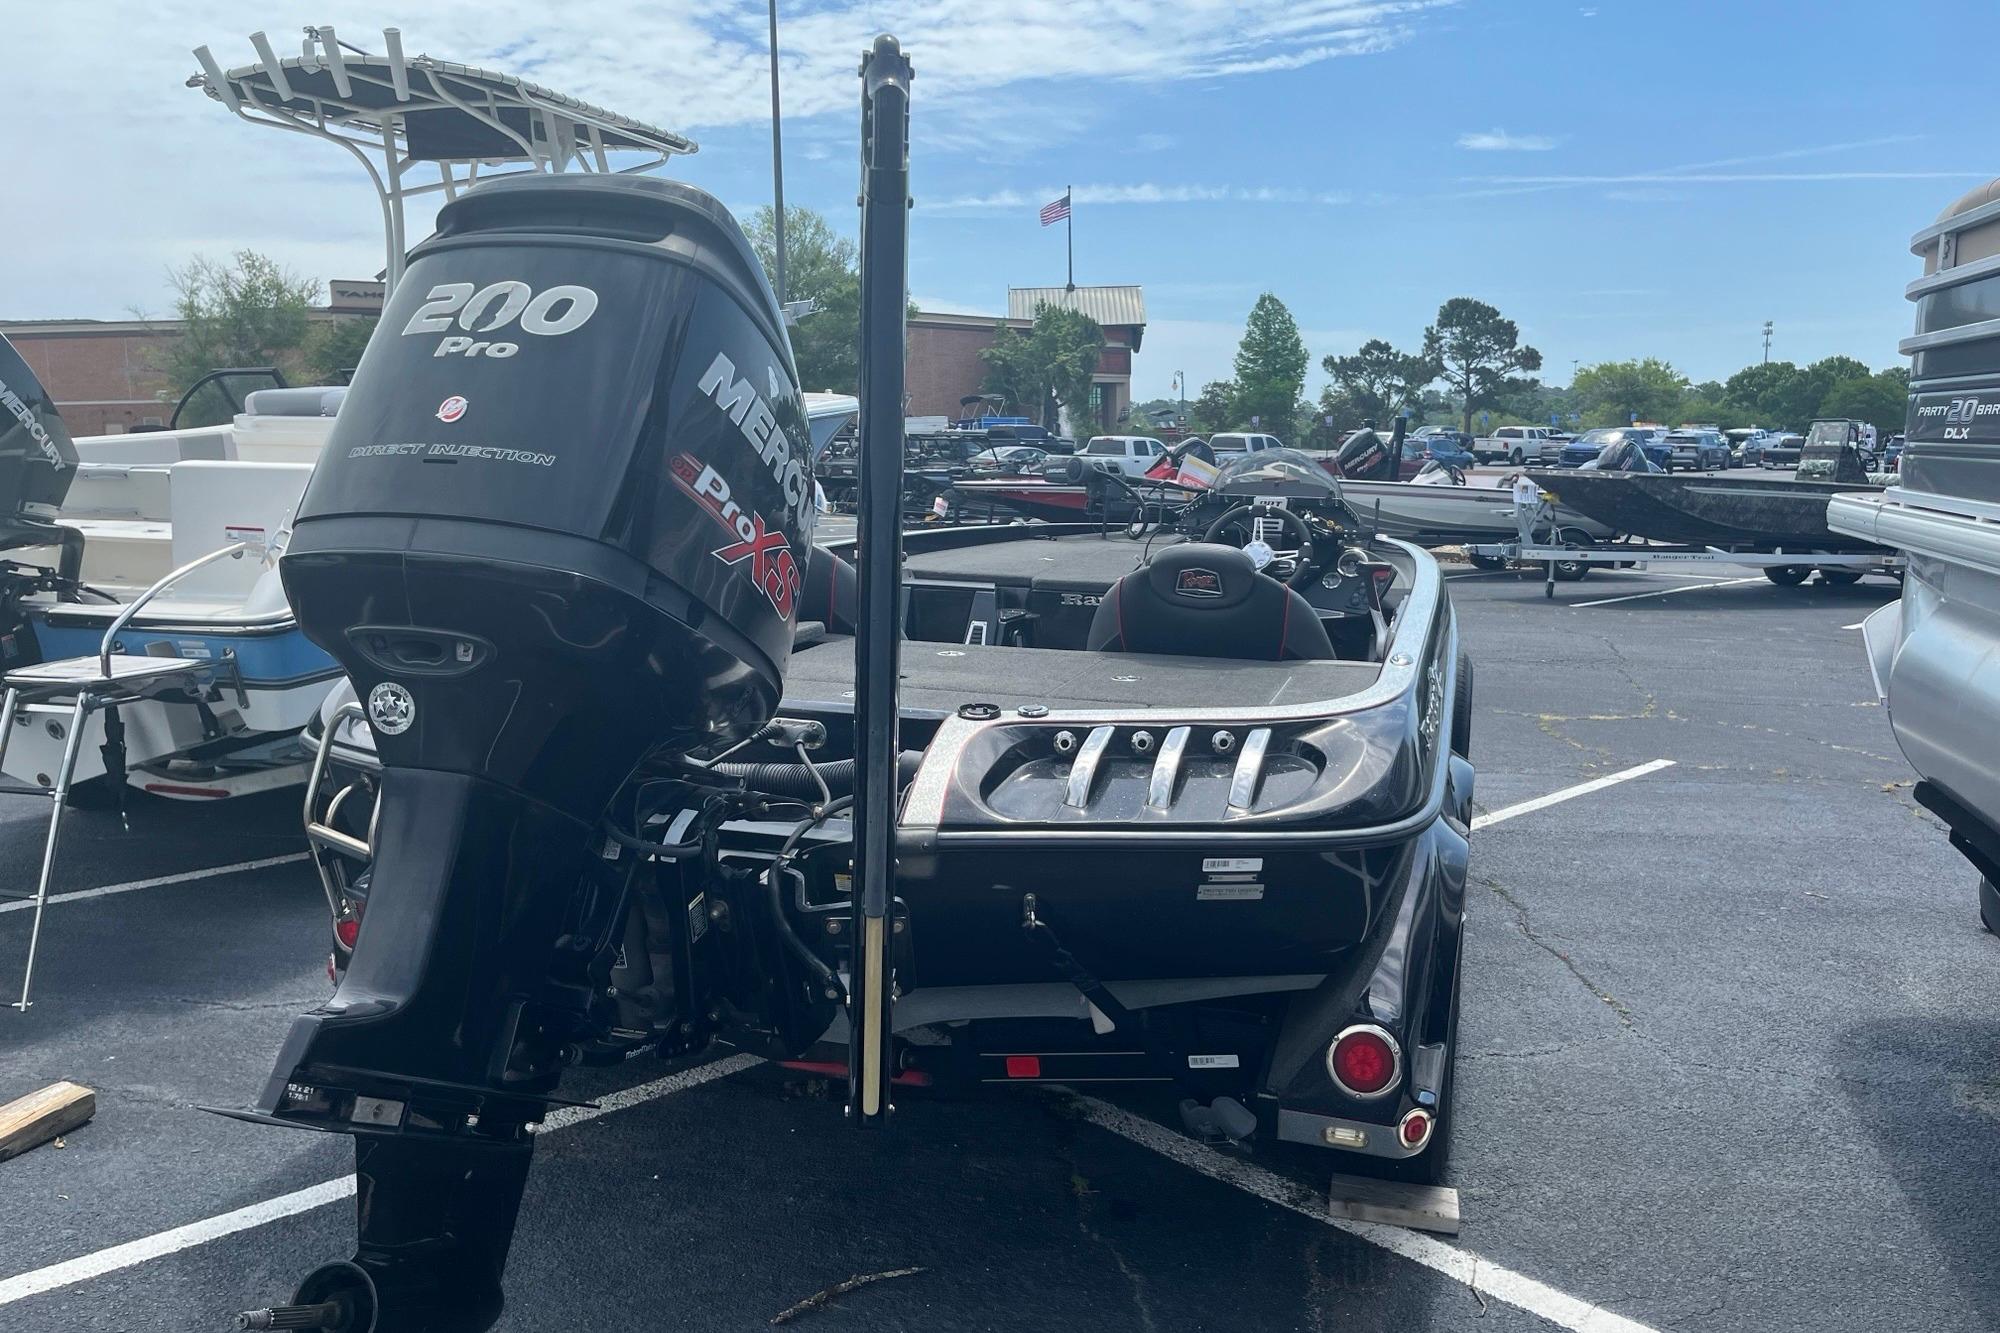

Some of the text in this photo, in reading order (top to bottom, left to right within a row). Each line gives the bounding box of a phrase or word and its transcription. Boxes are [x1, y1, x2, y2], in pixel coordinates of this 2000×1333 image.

[401, 280, 599, 336] 200
[433, 336, 519, 358] Pro
[1917, 396, 2000, 425] PARTY 20 BAR
[0, 379, 66, 473] MERCURY
[1943, 427, 1970, 440] DLX
[348, 443, 556, 466] DIRECT INJECTION
[288, 1083, 297, 1091] 12
[303, 1086, 314, 1095] 21
